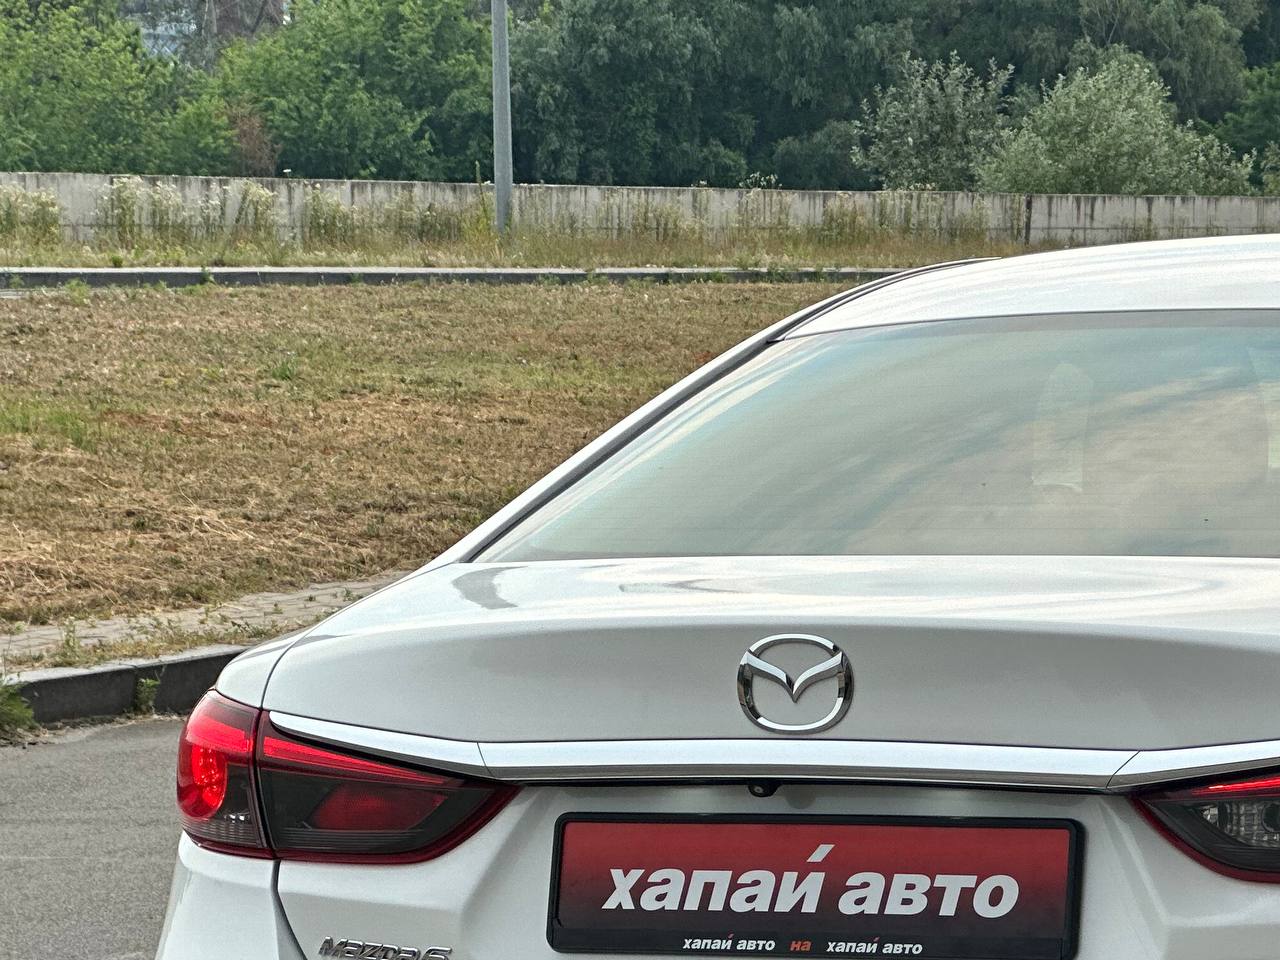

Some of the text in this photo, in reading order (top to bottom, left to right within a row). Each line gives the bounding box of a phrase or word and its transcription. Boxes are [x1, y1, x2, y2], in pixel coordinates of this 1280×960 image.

[837, 872, 1020, 918] авто
[736, 939, 776, 951] авто
[790, 940, 812, 952] на
[882, 942, 923, 955] авто
